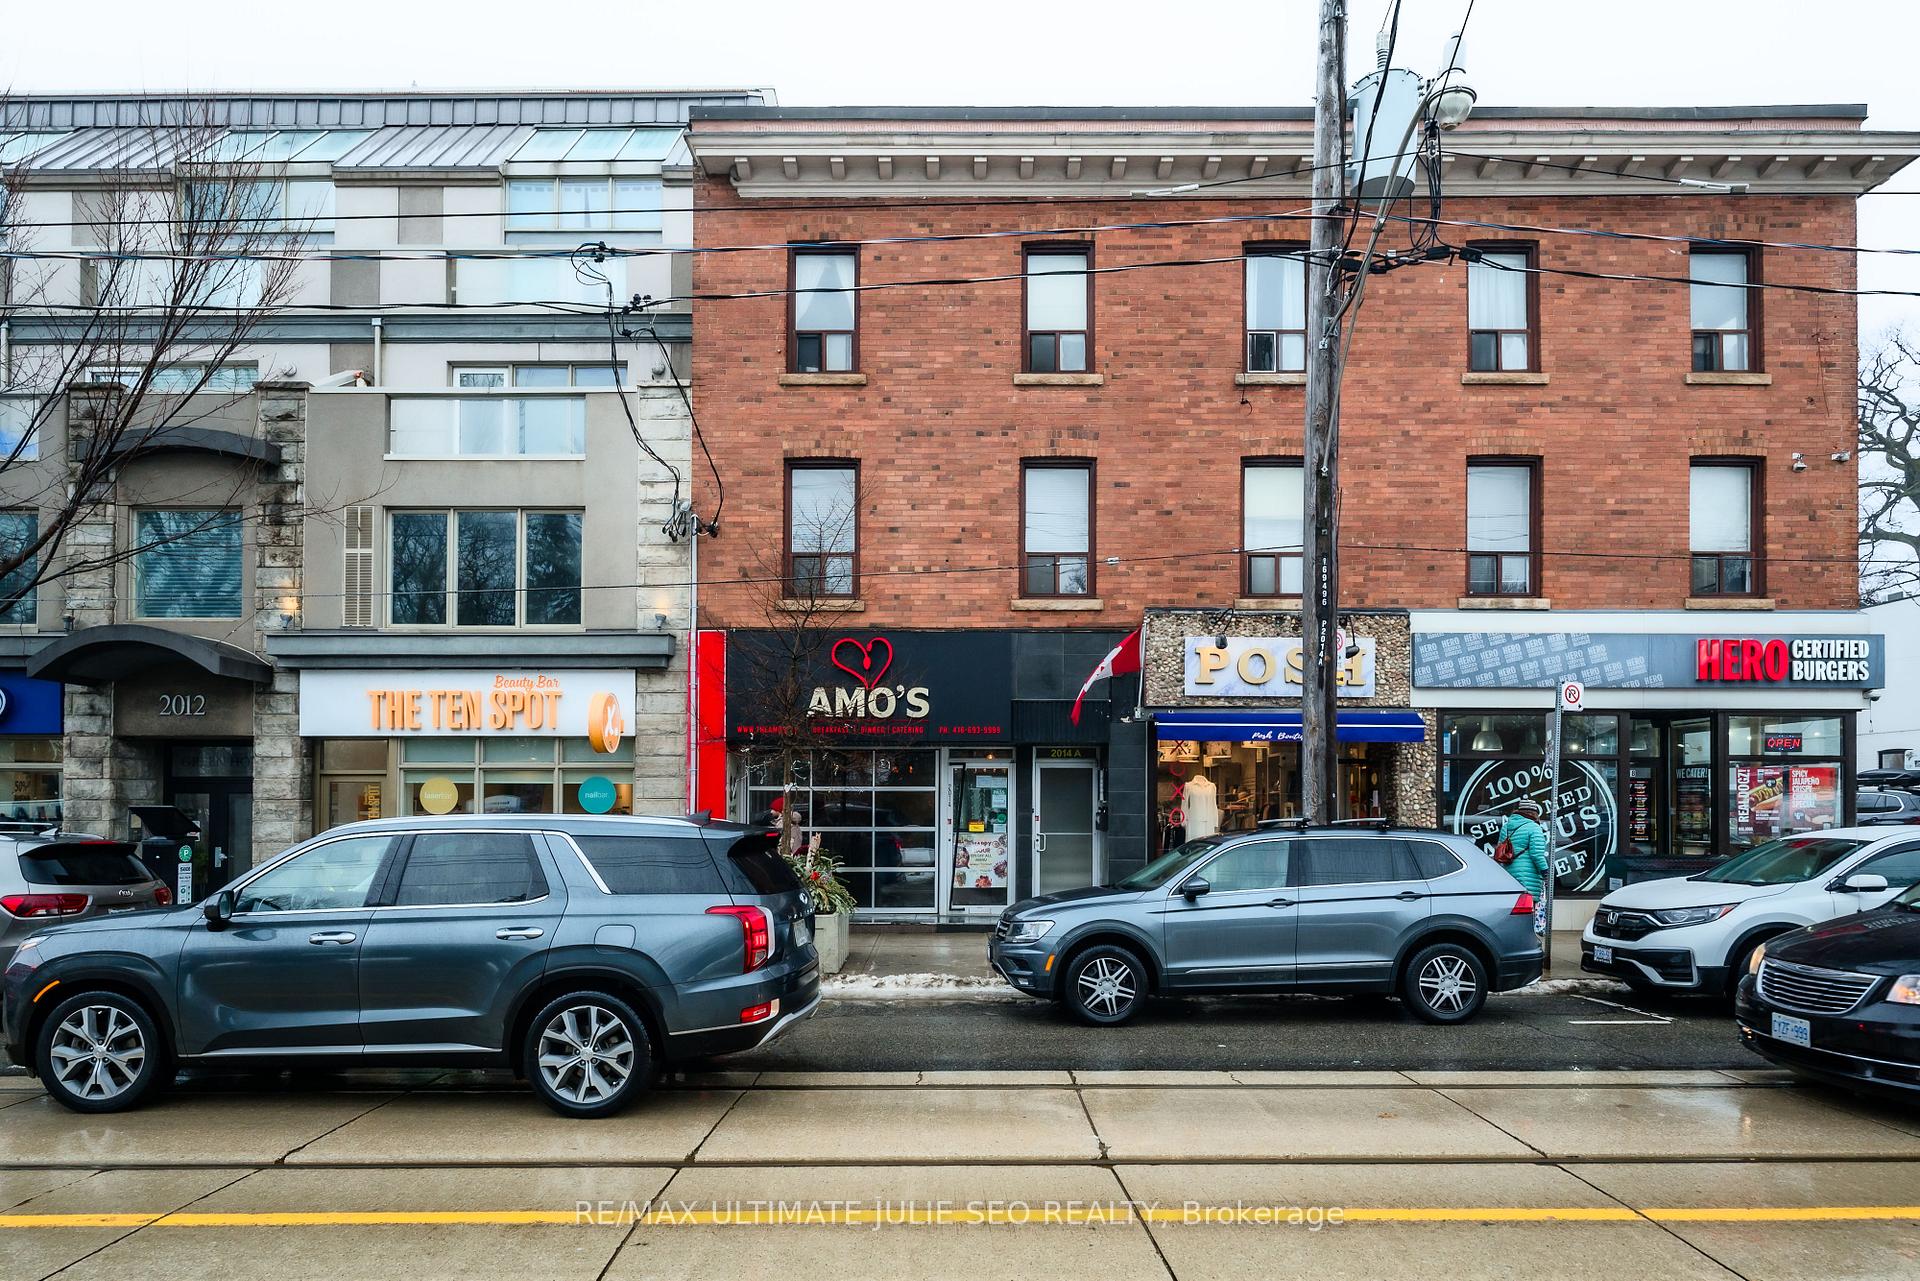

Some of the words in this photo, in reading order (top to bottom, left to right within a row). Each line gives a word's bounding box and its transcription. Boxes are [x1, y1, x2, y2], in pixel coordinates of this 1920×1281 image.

[1318, 620, 1327, 666] P2014A
[1792, 639, 1870, 658] CERTIFIED
[1697, 639, 1789, 681] HERO
[1792, 660, 1870, 681] BURGERS
[494, 674, 534, 692] Beauty
[537, 675, 560, 689] Bar
[159, 694, 207, 717] 2012
[368, 689, 421, 731] THE
[428, 689, 482, 731] TEN
[489, 689, 562, 731] SPOT
[806, 685, 930, 719] AMO'S
[892, 726, 924, 734] CATERING
[1051, 749, 1072, 758] 2014
[1074, 750, 1082, 758] A
[1767, 738, 1801, 748] OPEN
[1485, 763, 1554, 800] 100%
[1676, 768, 1685, 778] WE
[1686, 768, 1708, 778] CATER!
